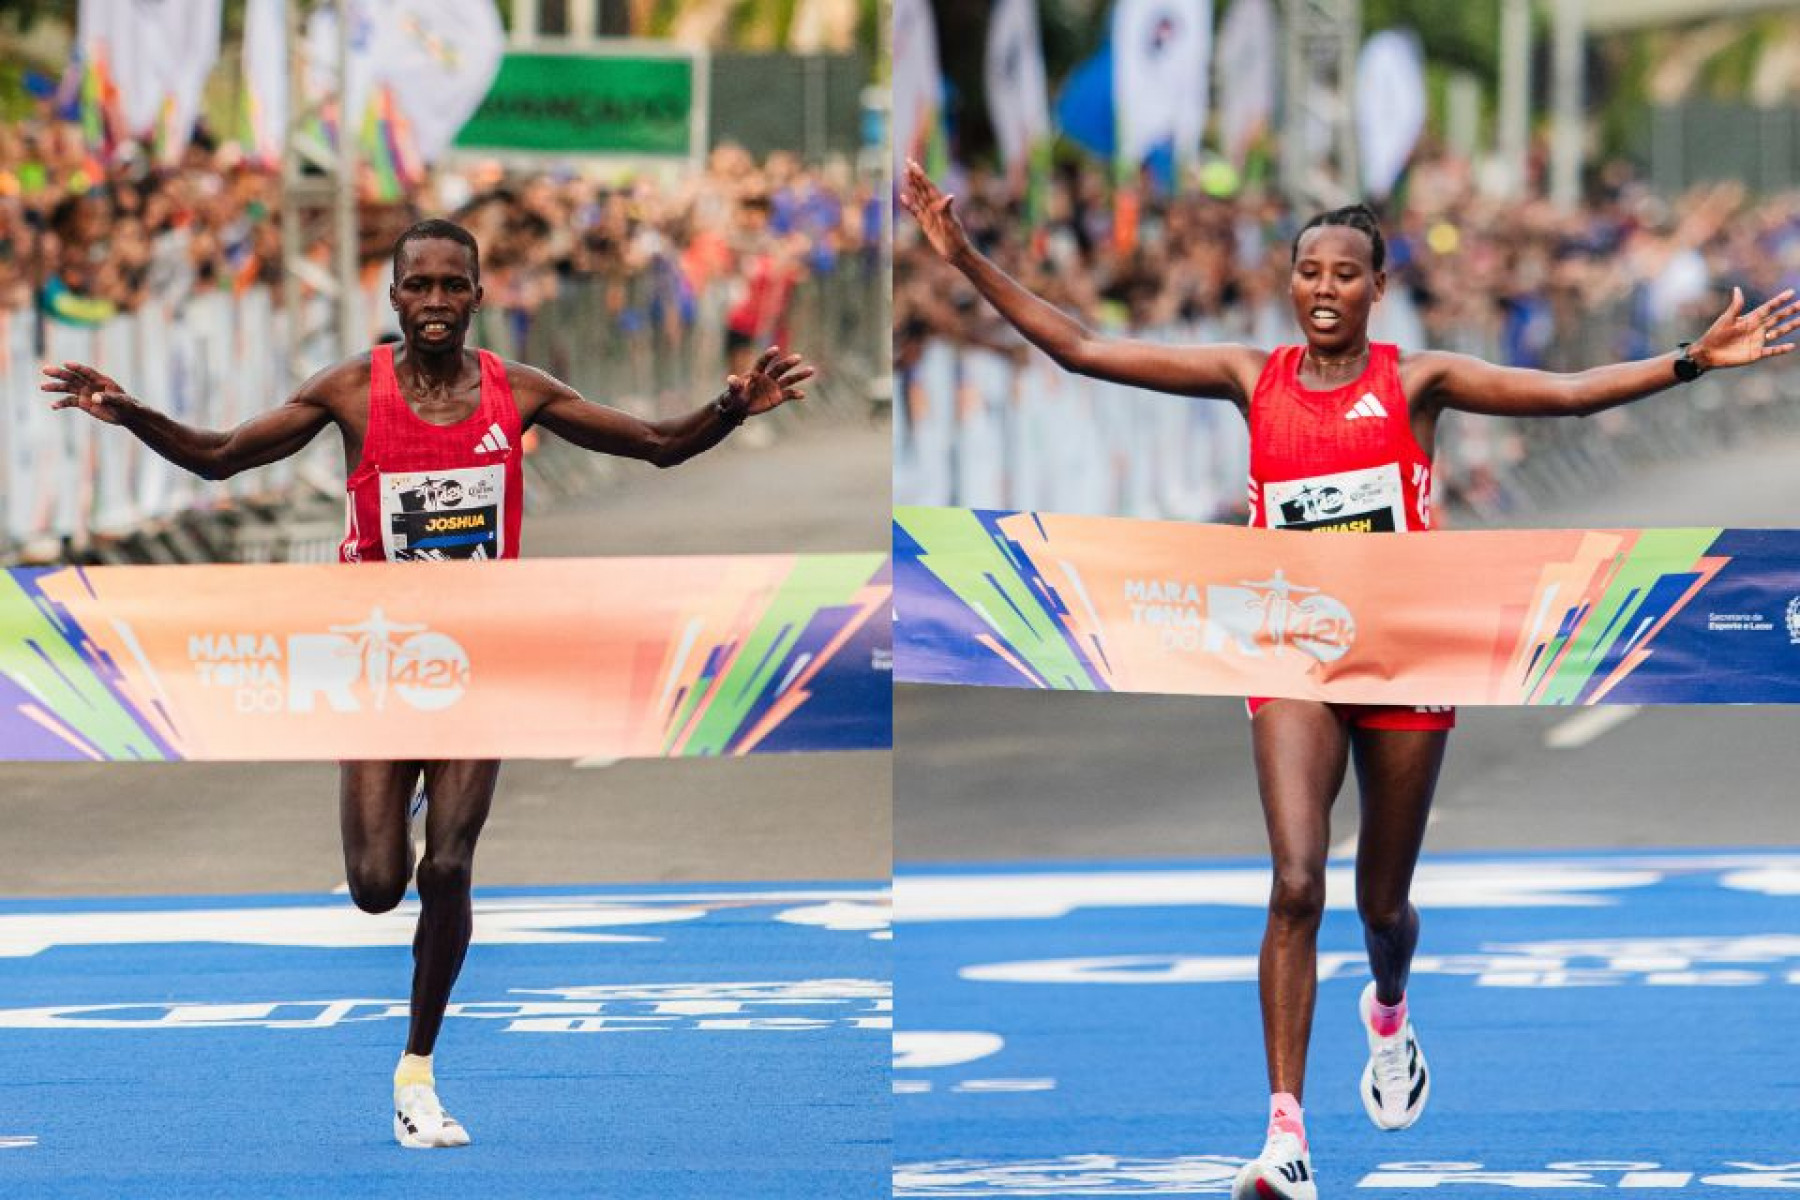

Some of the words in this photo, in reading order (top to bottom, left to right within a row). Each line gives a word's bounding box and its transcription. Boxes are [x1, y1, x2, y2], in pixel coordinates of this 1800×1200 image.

[425, 513, 485, 532] JOSHUA
[1124, 580, 1200, 603] MARA
[188, 632, 282, 660] MARA
[195, 661, 282, 686] TONA
